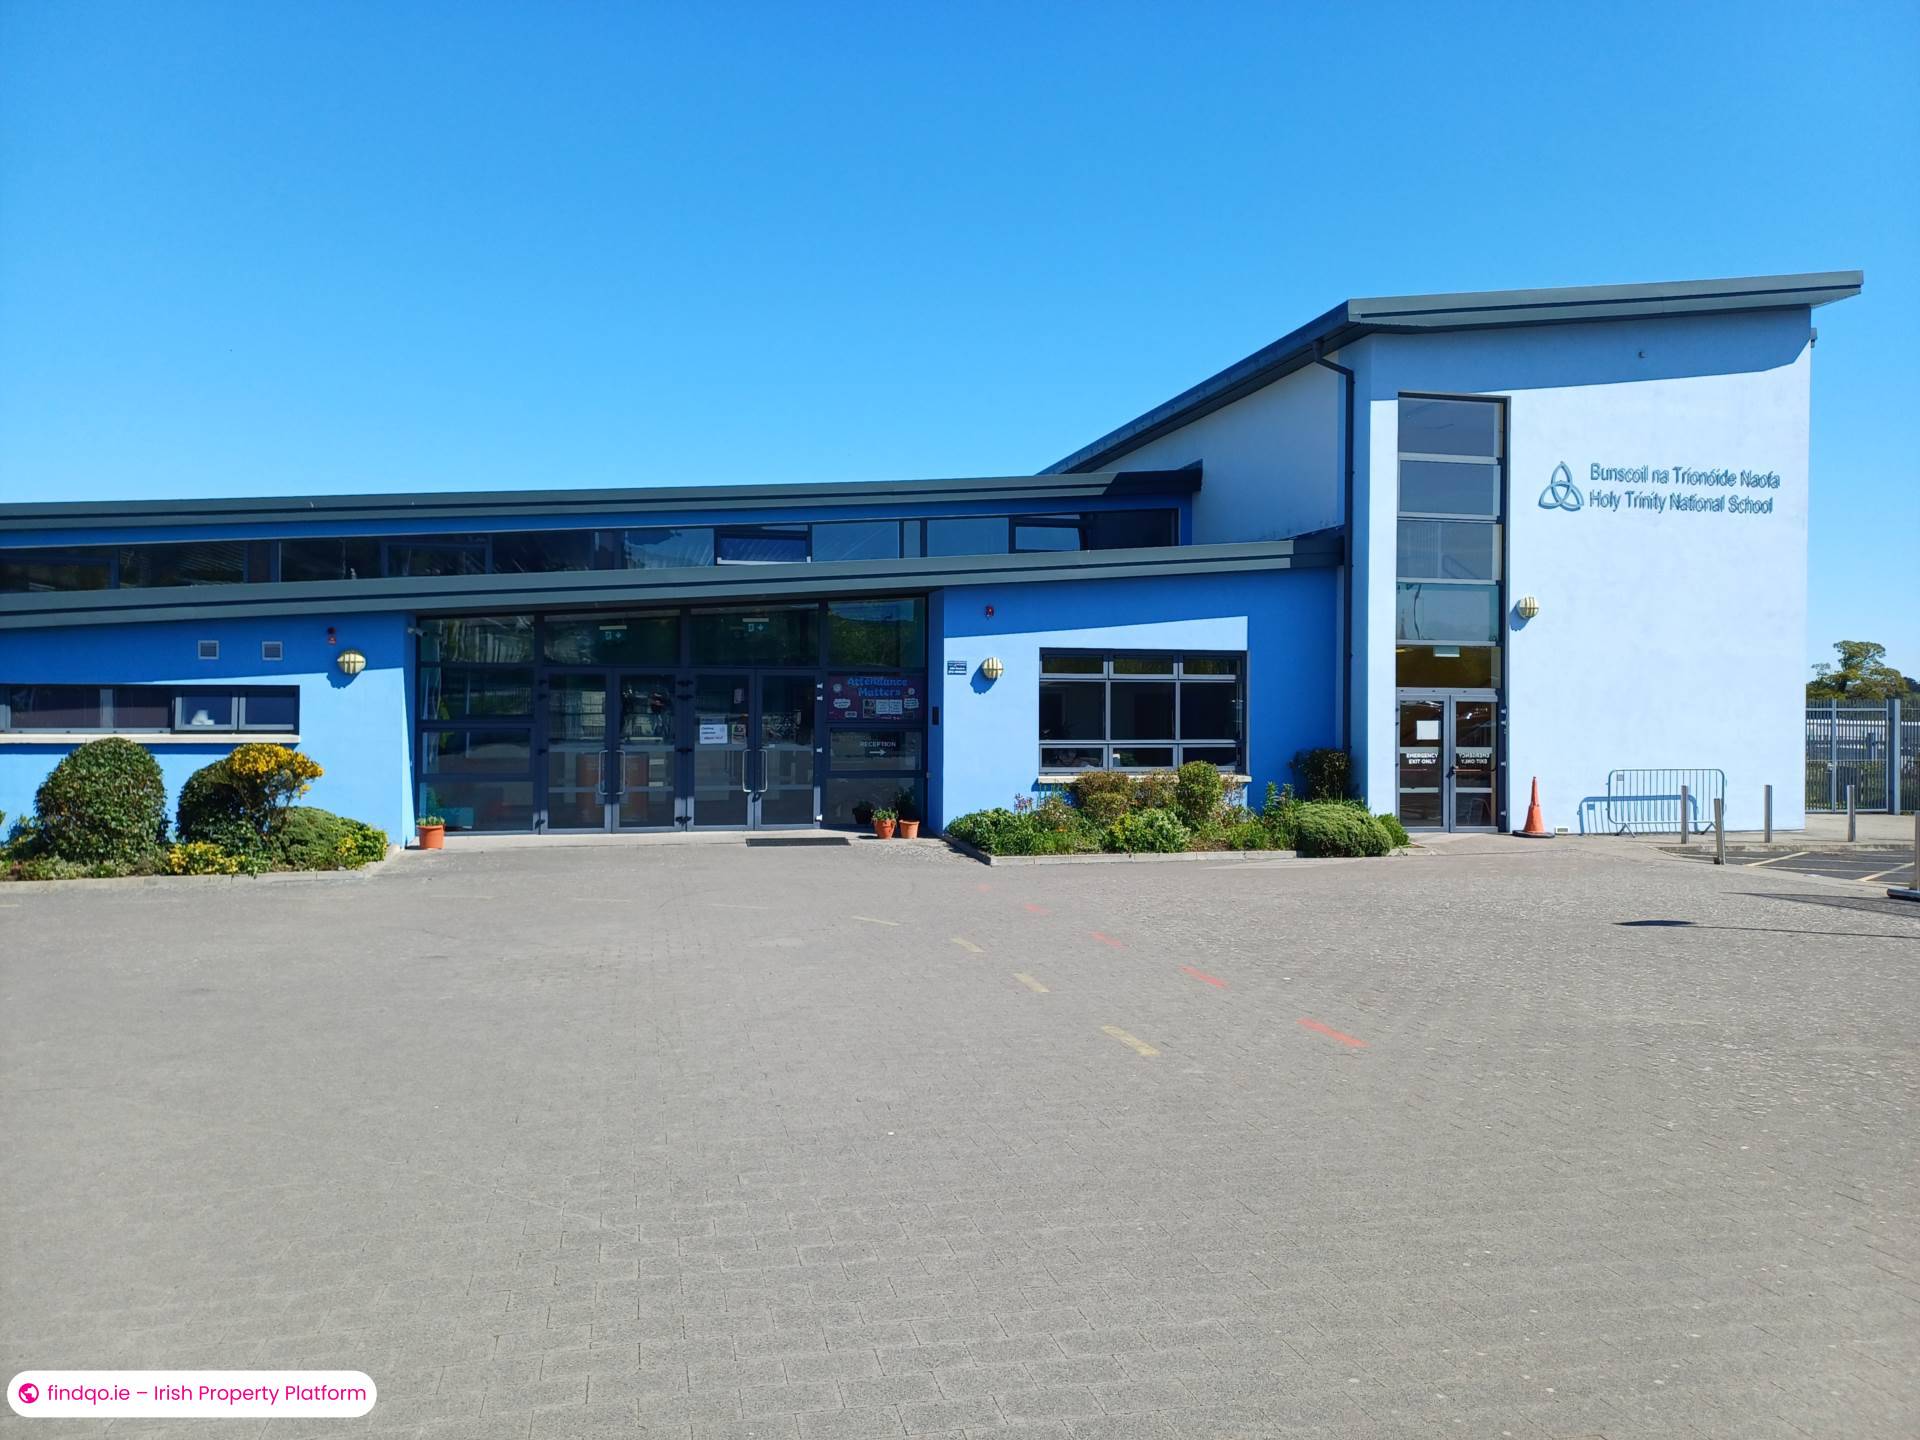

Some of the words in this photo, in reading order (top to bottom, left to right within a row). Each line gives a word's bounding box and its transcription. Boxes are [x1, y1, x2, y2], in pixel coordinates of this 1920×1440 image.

[1590, 462, 1648, 483] Bunscoil
[1651, 469, 1669, 485] na
[1740, 469, 1781, 489] Naofa
[1589, 489, 1621, 512] Holy
[1625, 490, 1666, 513] Trinity
[1669, 492, 1726, 513] National
[1728, 494, 1773, 514] School
[847, 676, 909, 687] Attendance
[858, 686, 902, 697] Matters
